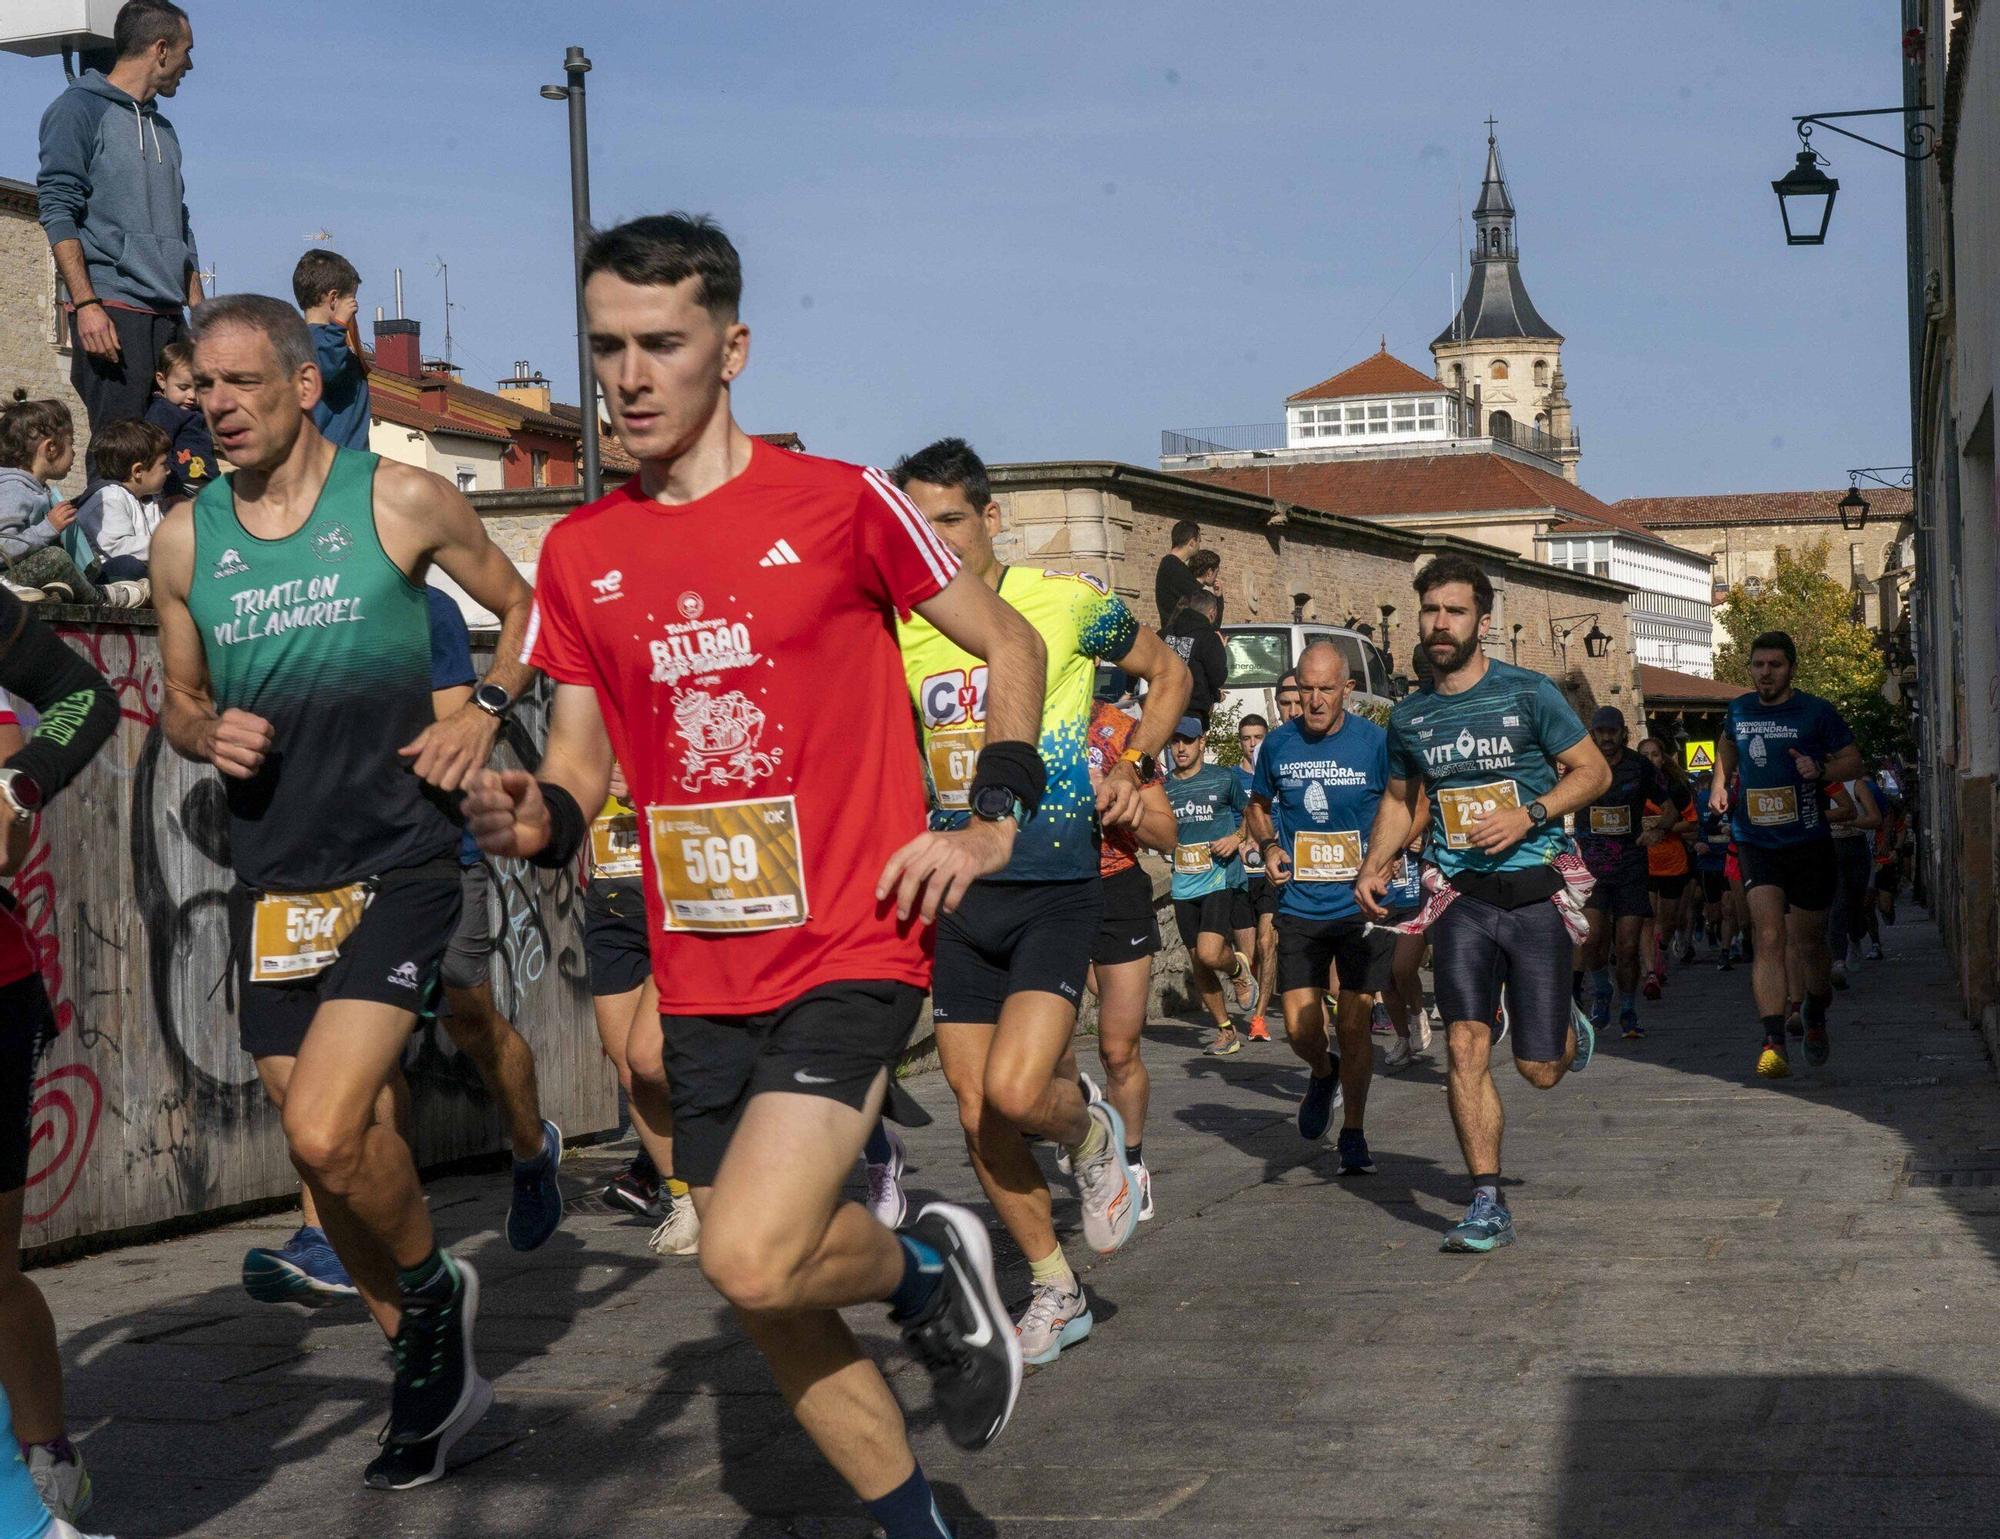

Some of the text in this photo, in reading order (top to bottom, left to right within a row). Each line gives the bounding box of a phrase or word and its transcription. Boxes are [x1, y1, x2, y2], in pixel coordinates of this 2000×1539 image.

[213, 597, 366, 647] VILLAMURIEL
[649, 622, 752, 666] BILBAO
[1740, 725, 1789, 735] ALMENDRA
[948, 750, 981, 781] 67
[1289, 760, 1337, 770] CONQUISTA
[1476, 756, 1516, 770] TRAIL
[1291, 767, 1355, 779] ALMENDRA
[1324, 777, 1366, 786] KONKISTA
[681, 833, 760, 885] 569
[1311, 844, 1345, 863] 689
[285, 906, 343, 944] 554
